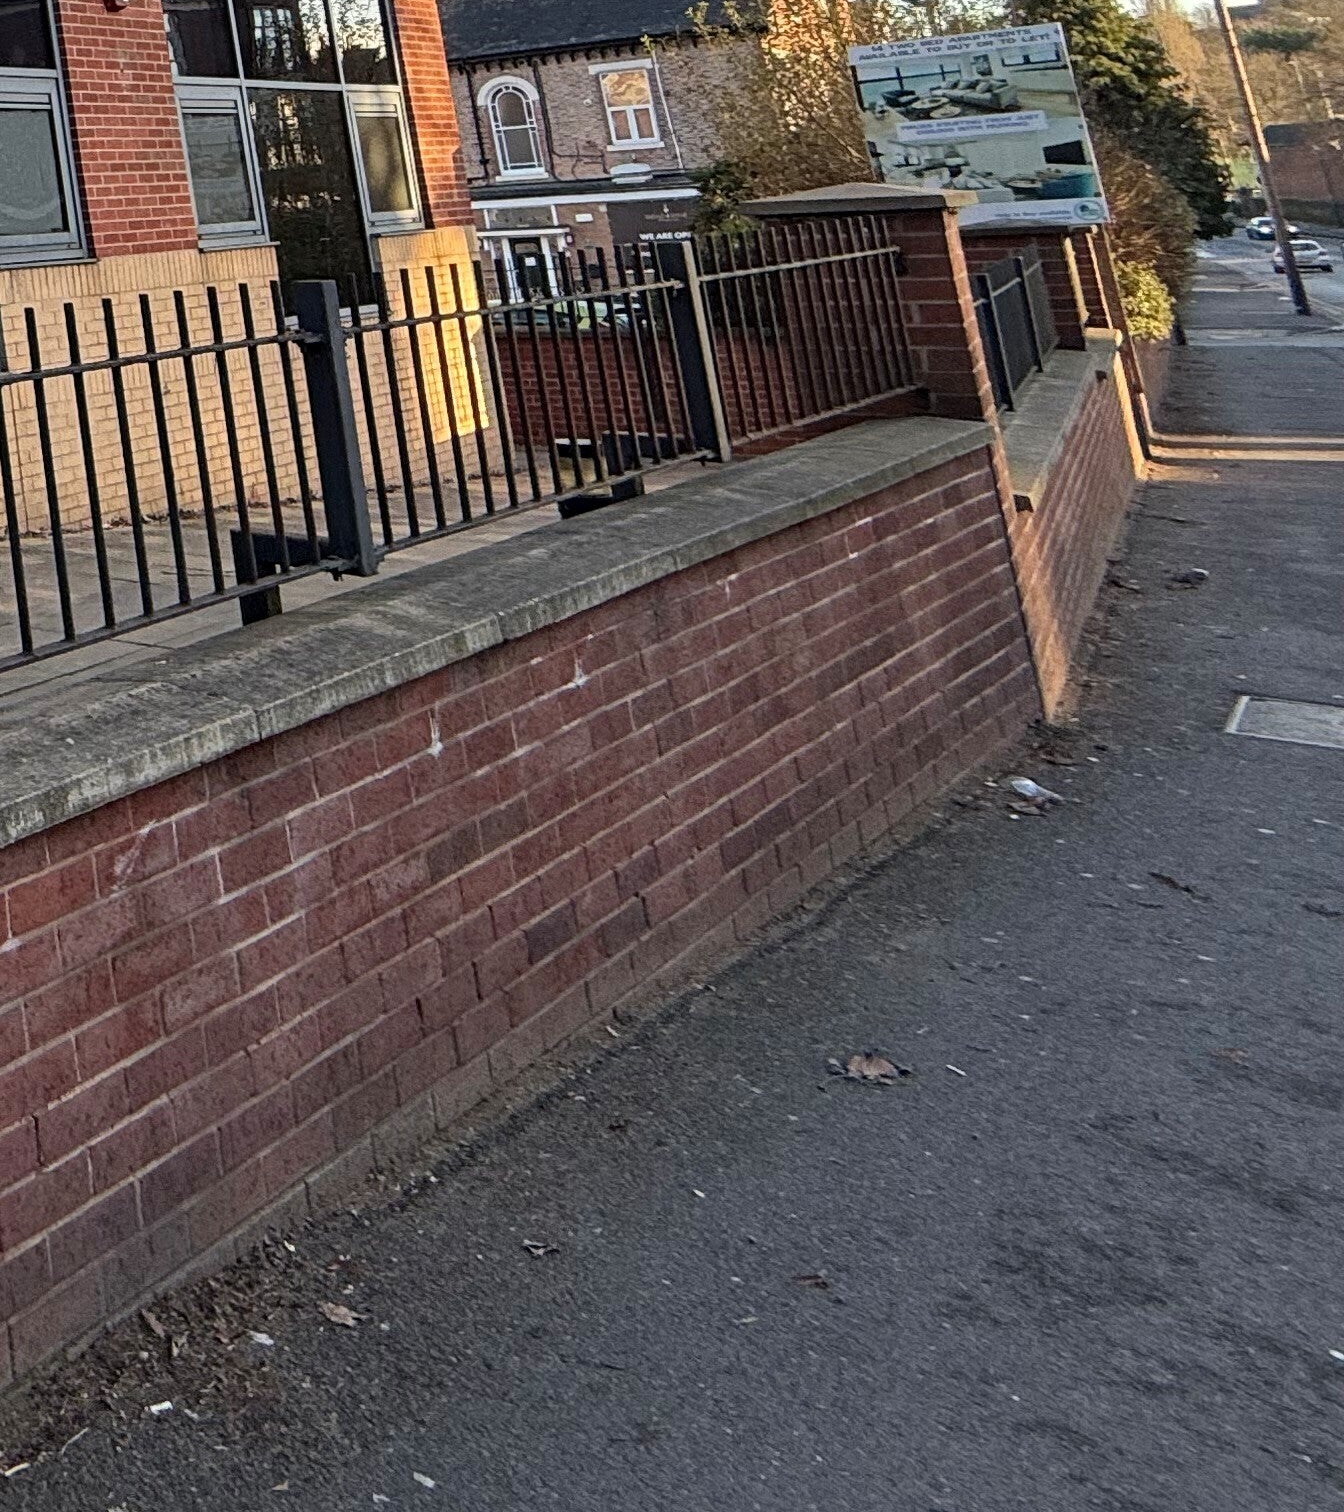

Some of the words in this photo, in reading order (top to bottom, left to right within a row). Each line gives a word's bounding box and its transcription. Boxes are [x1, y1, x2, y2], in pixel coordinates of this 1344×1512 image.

[858, 48, 921, 61] AVAILABLE
[926, 45, 942, 54] TO
[947, 42, 972, 52] BUY
[977, 39, 994, 48] OR
[999, 35, 1016, 45] TO
[889, 42, 916, 51] TWO
[920, 38, 943, 47] BED
[948, 29, 1032, 43] APARTMENTS
